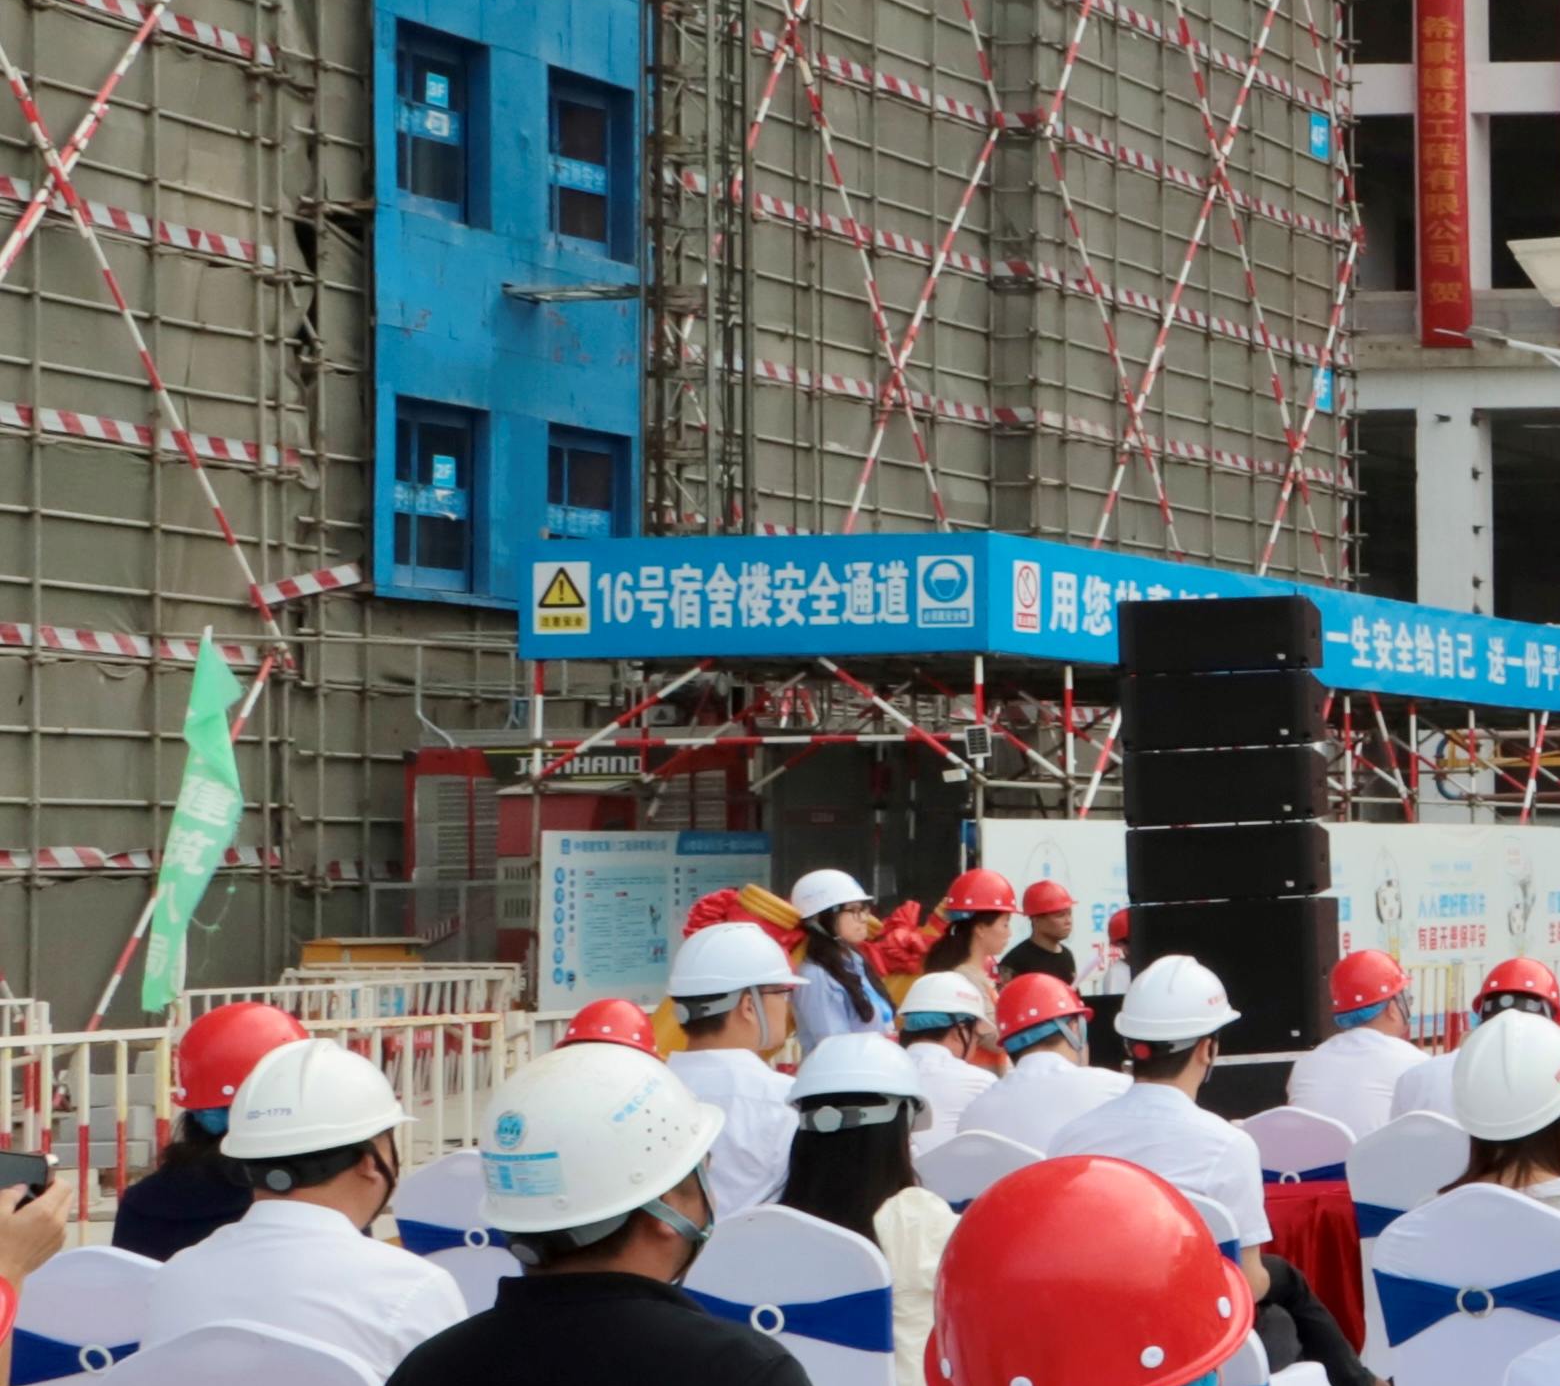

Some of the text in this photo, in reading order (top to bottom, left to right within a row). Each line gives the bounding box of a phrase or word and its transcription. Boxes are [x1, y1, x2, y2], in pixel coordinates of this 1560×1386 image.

[597, 560, 910, 628] 16号宿舍楼安全通道
[1325, 615, 1476, 680] 一生安全给自己
